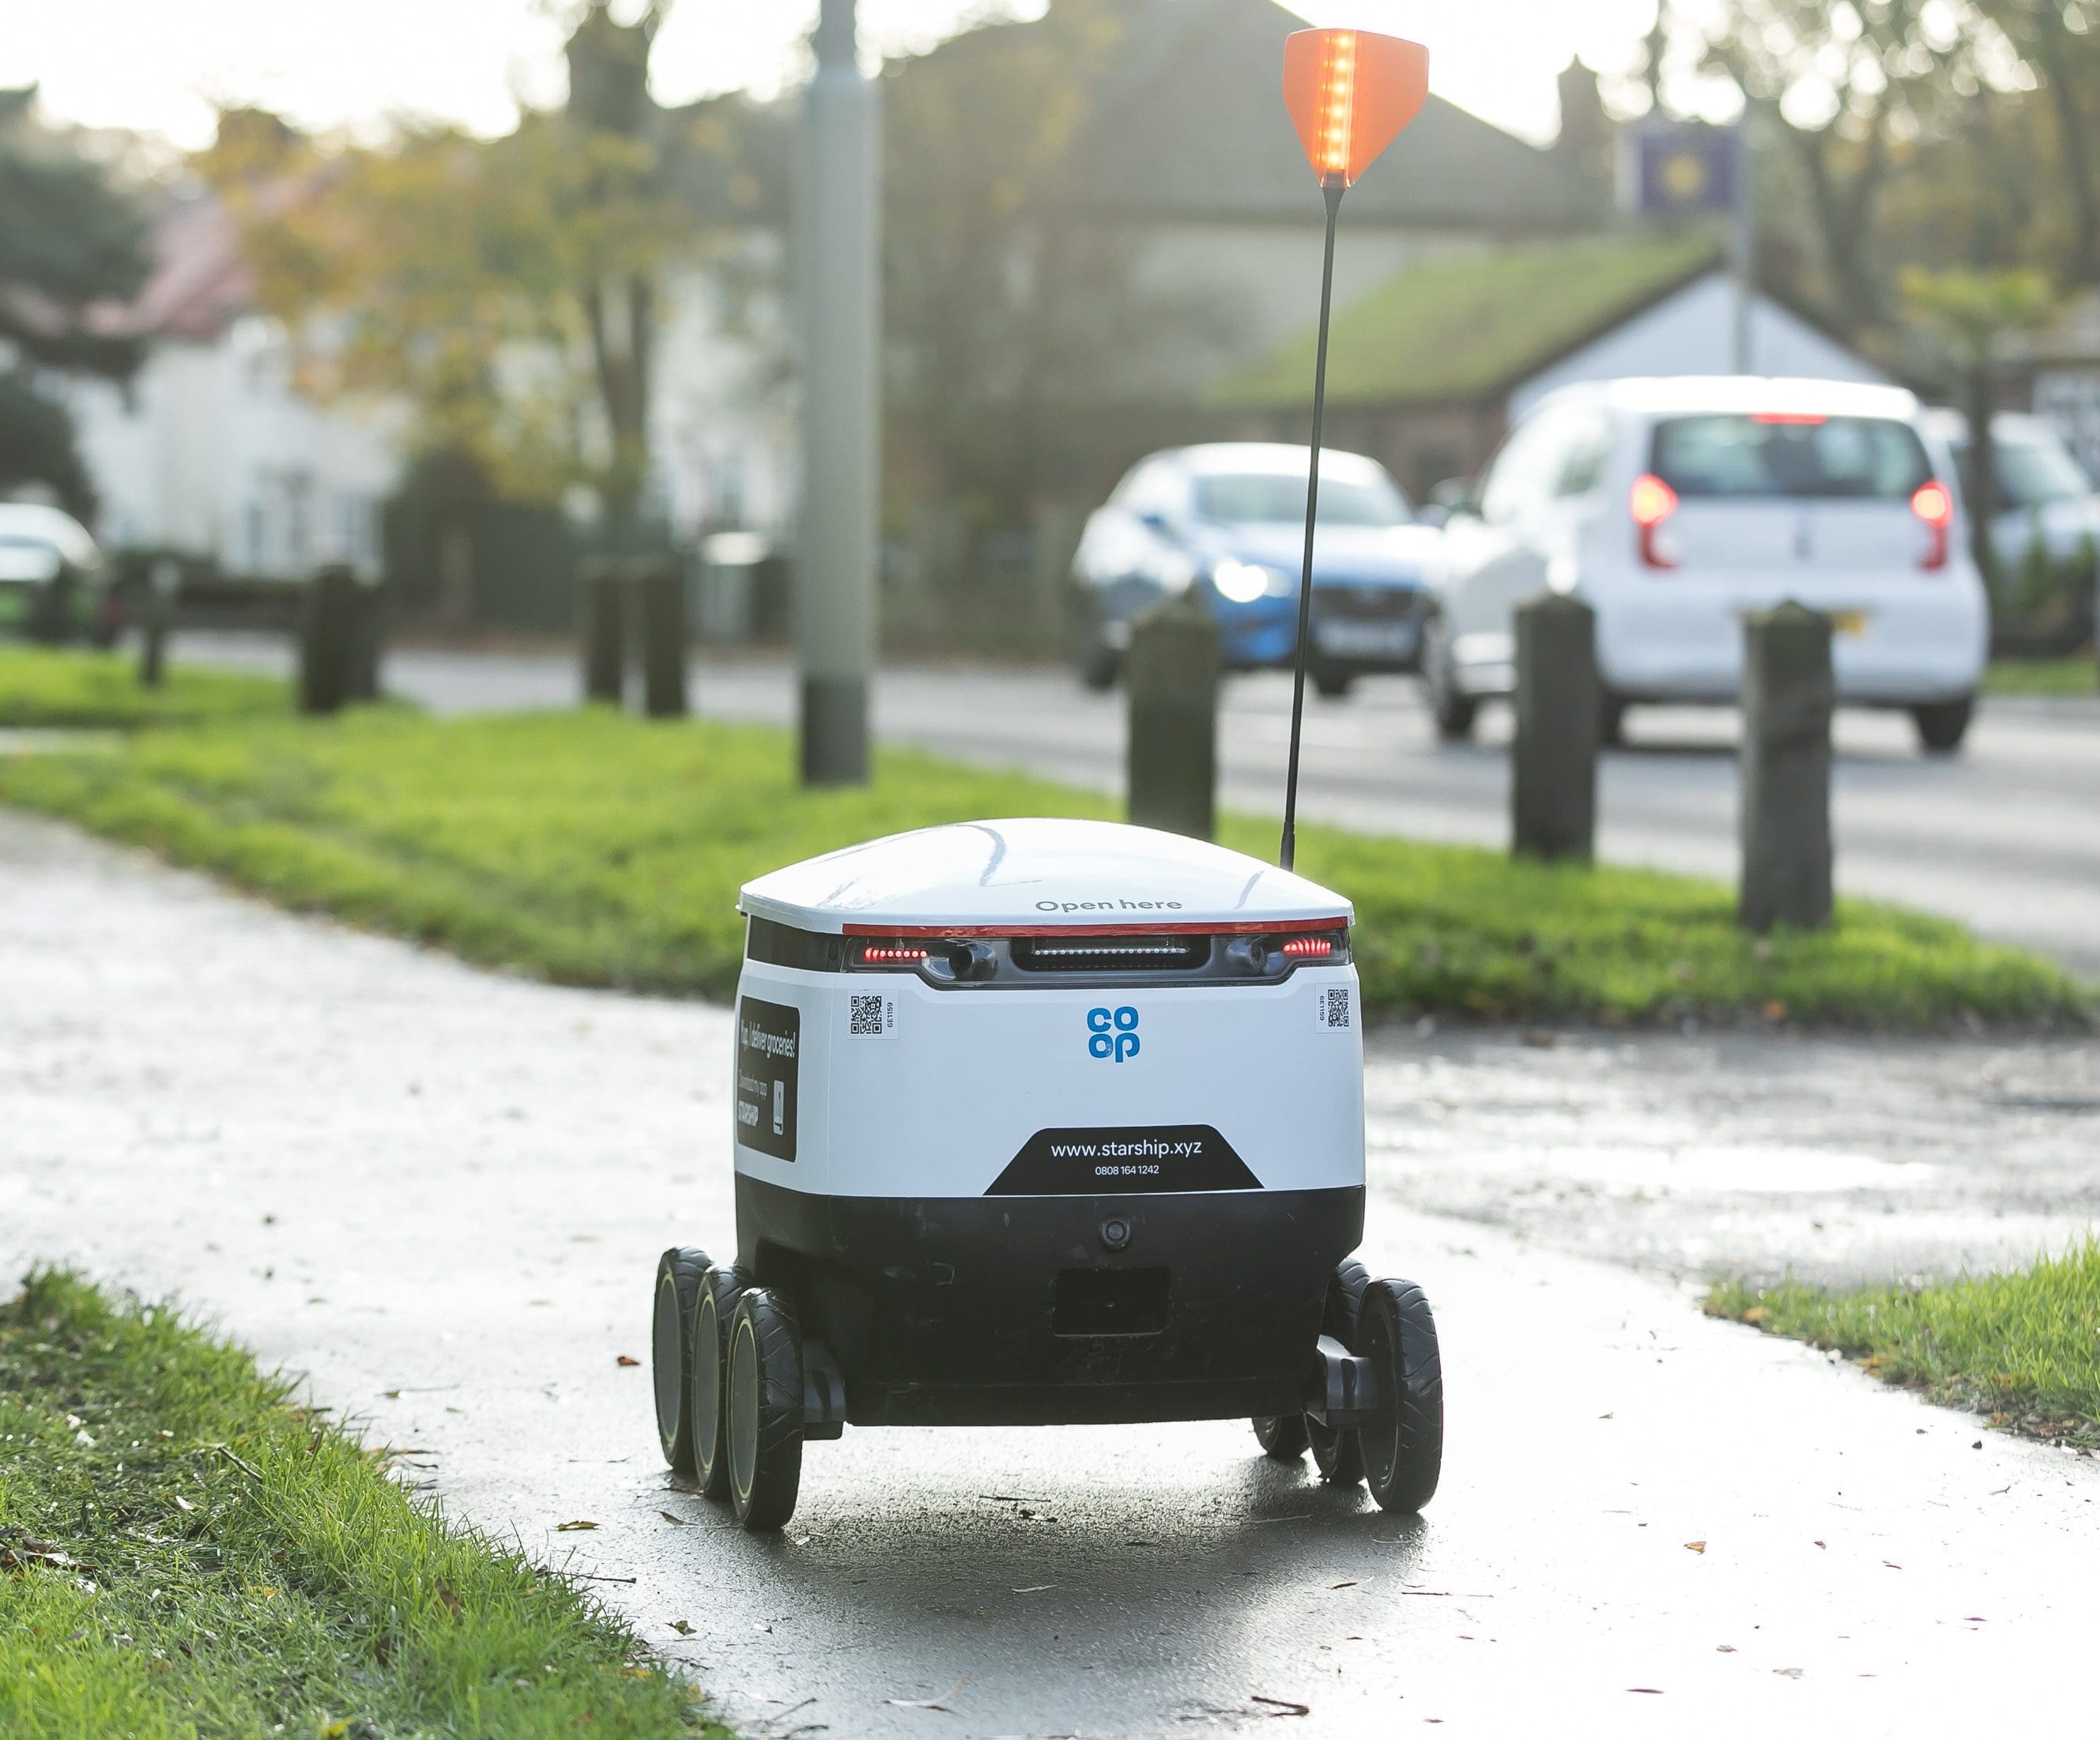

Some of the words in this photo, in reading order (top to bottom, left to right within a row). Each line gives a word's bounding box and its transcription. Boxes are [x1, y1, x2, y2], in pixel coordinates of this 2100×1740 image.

[1035, 900, 1114, 913] Open
[1119, 899, 1182, 910] here
[767, 1031, 796, 1059] groceries!
[1050, 1138, 1202, 1159] www.starship.xyz
[1095, 1166, 1119, 1176] 0808
[1120, 1165, 1137, 1175] 164
[1138, 1164, 1159, 1175] 1242
